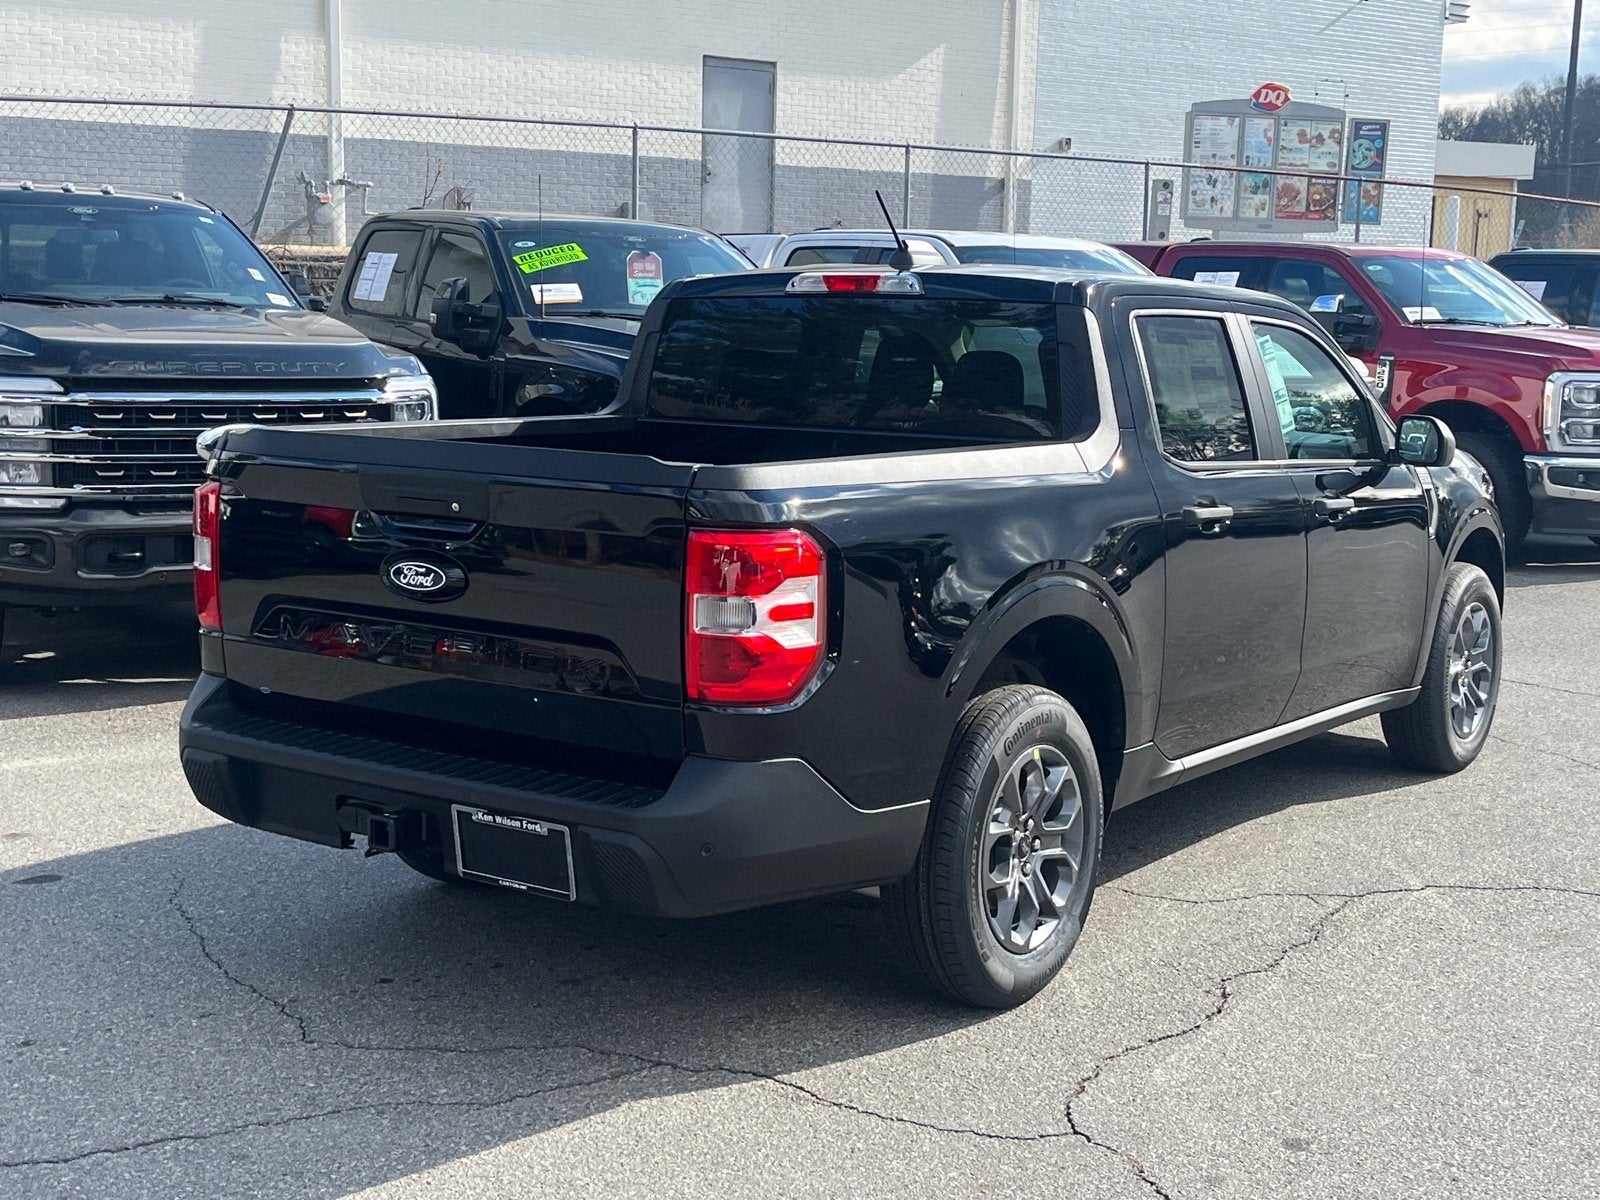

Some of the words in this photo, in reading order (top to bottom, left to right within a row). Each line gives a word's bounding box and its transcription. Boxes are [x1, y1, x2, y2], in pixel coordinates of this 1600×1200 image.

[1258, 88, 1286, 106] DQ
[518, 244, 576, 263] REDUCED
[528, 262, 539, 271] AS
[539, 253, 580, 268] ADVERTISED
[108, 360, 247, 375] SUPER
[254, 361, 347, 373] DUTY
[399, 564, 435, 587] Ford
[1003, 709, 1053, 757] Continental
[477, 811, 494, 822] Ken
[494, 815, 521, 828] Wilson
[522, 820, 542, 832] Ford
